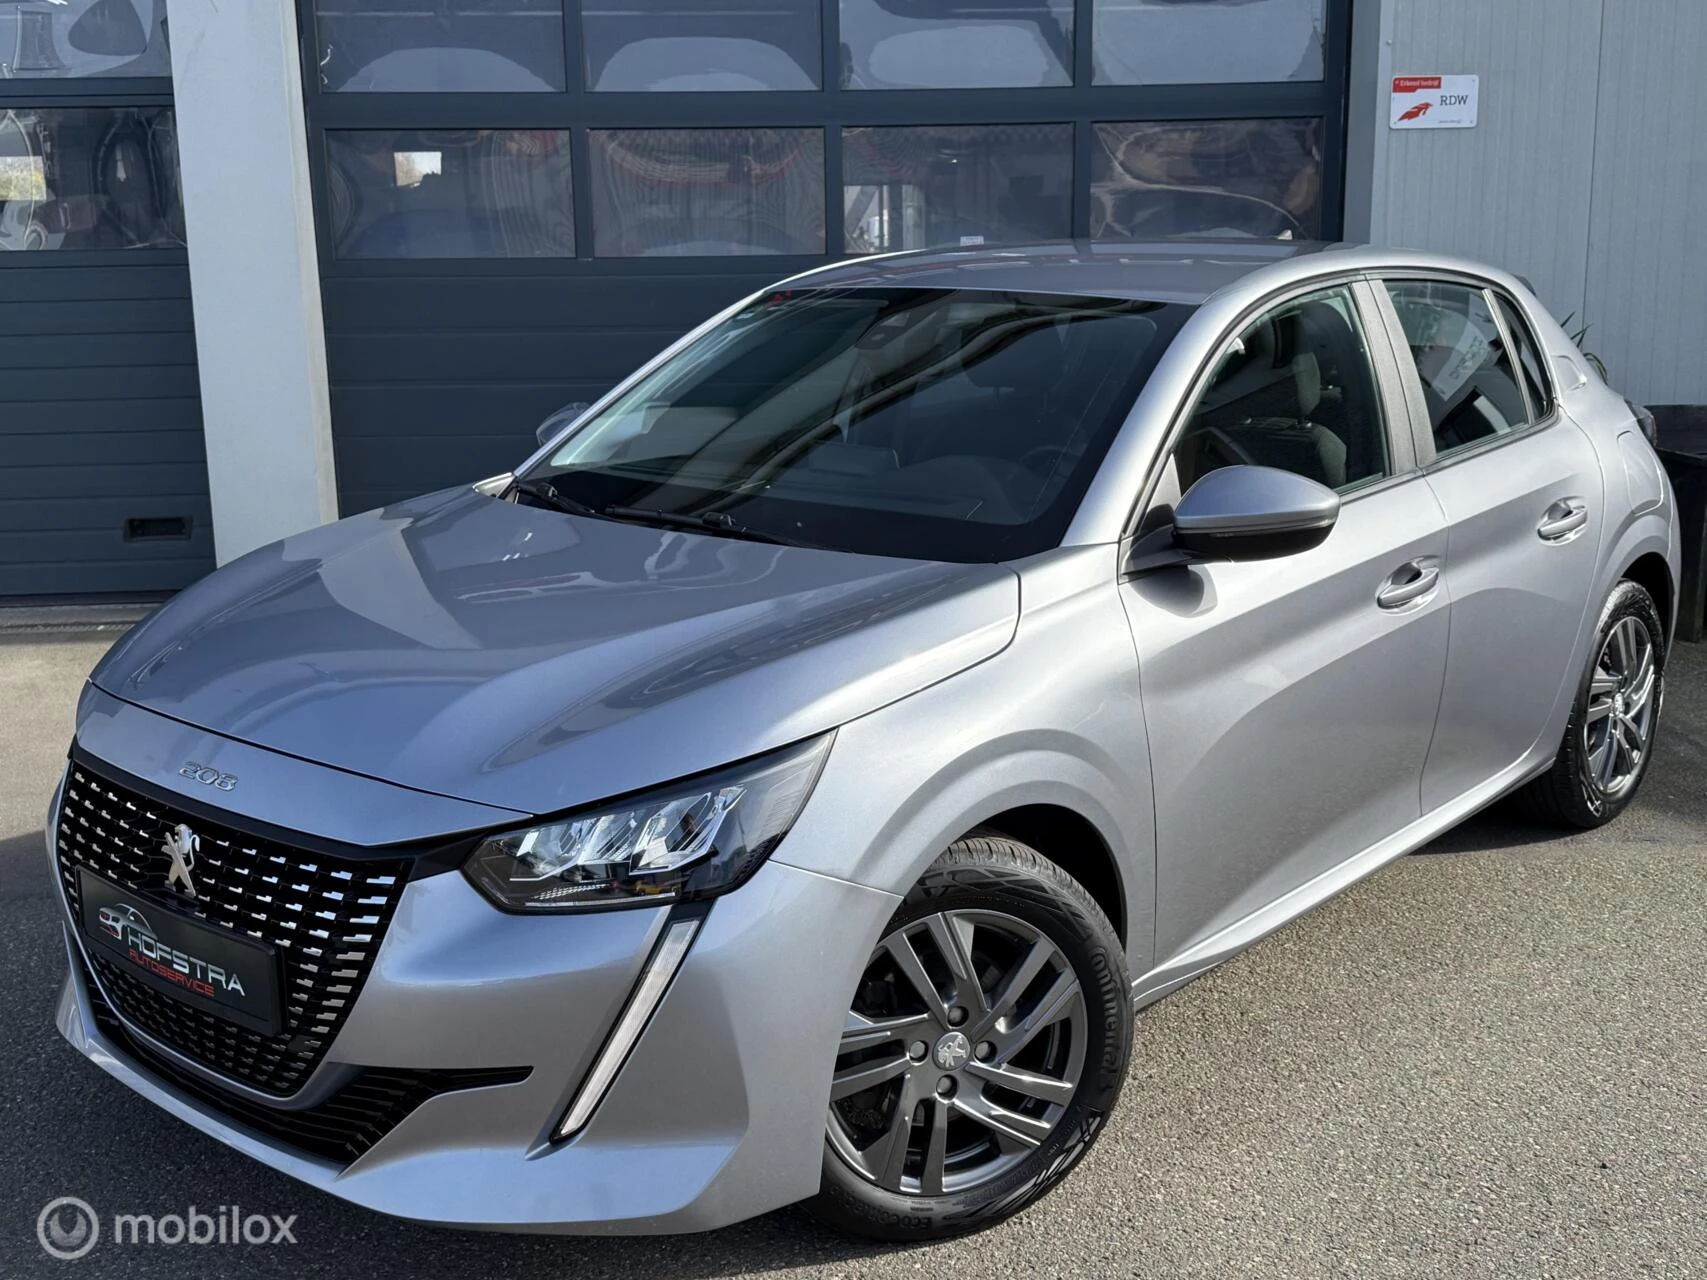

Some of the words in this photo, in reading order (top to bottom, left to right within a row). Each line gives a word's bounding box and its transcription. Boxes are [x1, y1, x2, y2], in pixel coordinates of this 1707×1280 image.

[1440, 94, 1469, 106] RDW
[179, 761, 239, 792] 208
[127, 926, 246, 997] HOFSTRA
[129, 949, 216, 998] AUTOSERVICE
